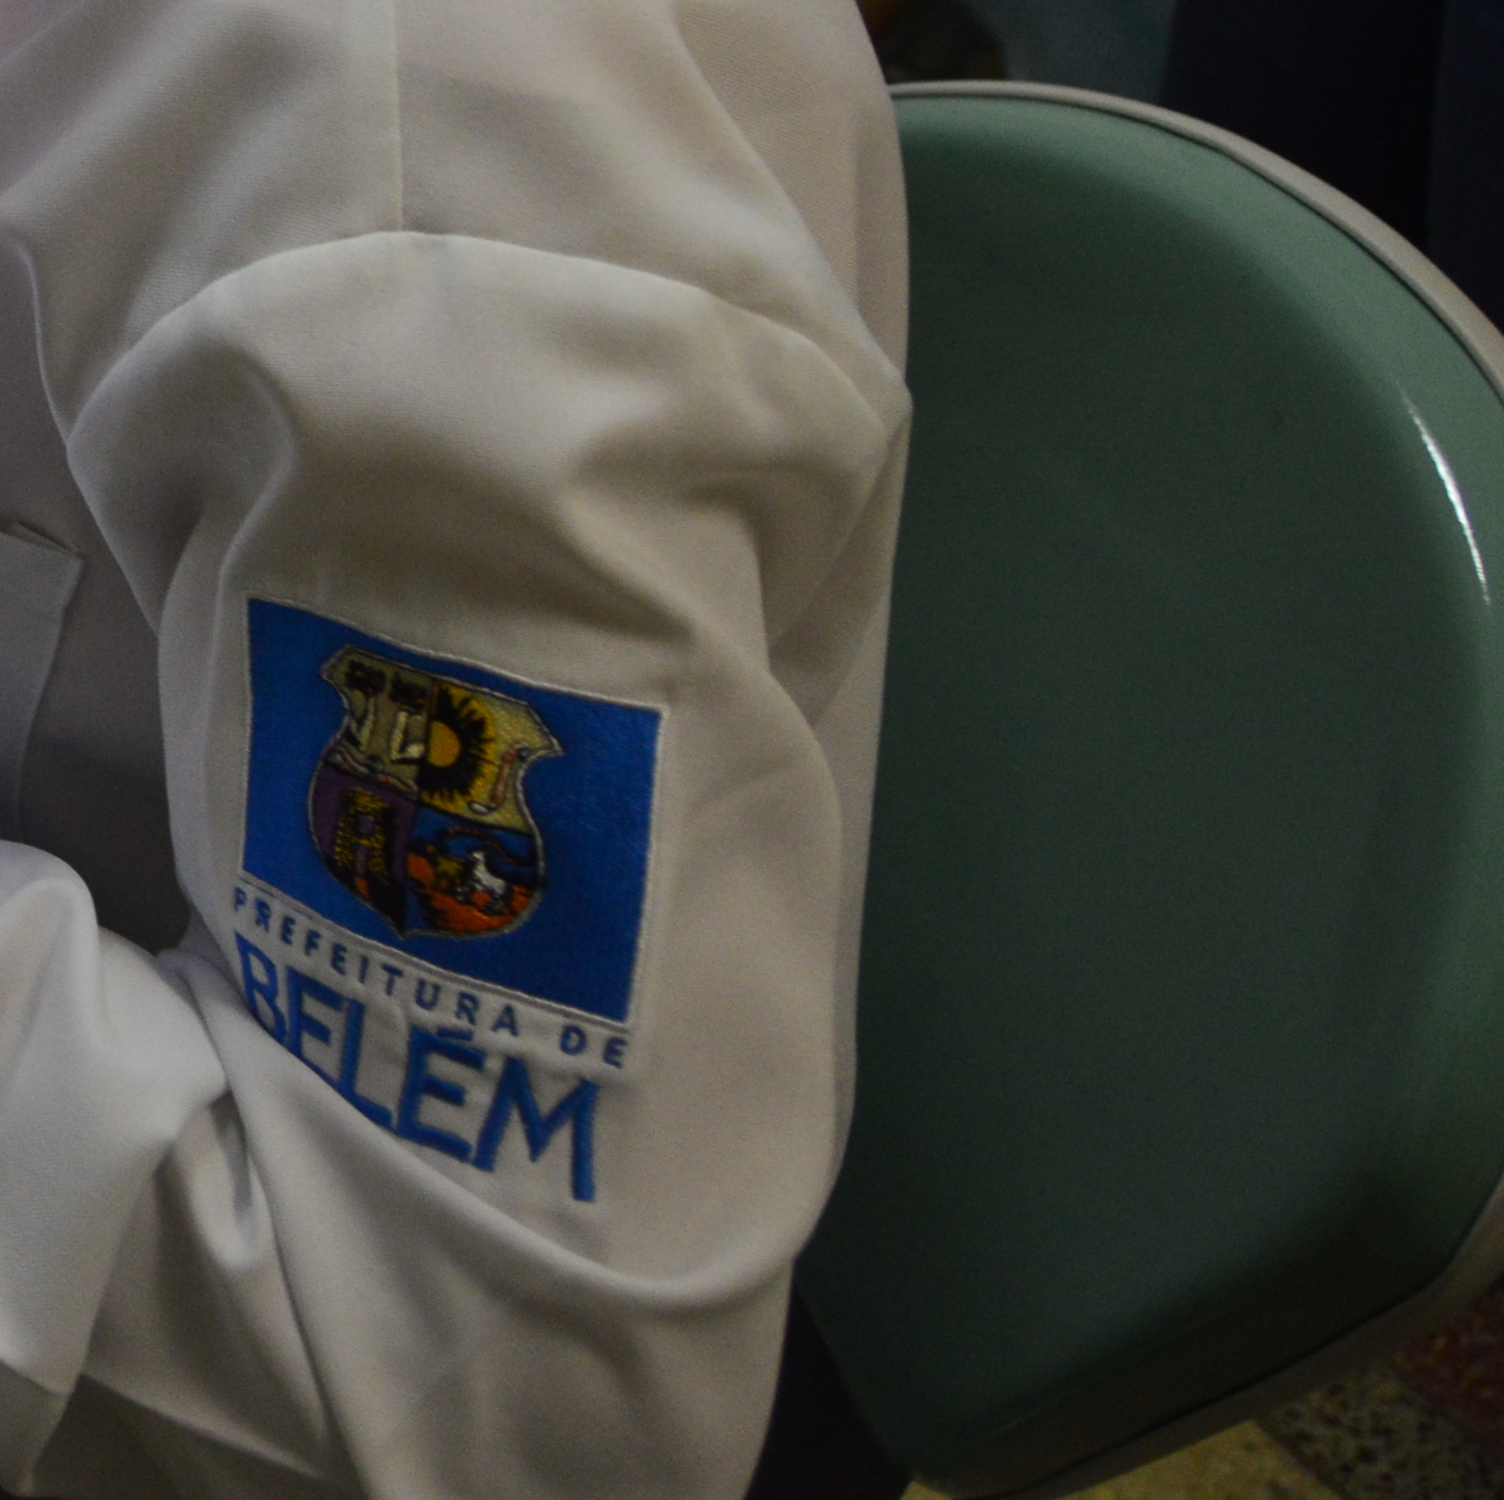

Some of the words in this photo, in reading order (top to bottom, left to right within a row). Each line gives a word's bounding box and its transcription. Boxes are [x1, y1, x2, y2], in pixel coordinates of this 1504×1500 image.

[232, 886, 520, 1037] PREFEITURA
[559, 1024, 629, 1069] DE
[234, 930, 602, 1202] BELÉM
